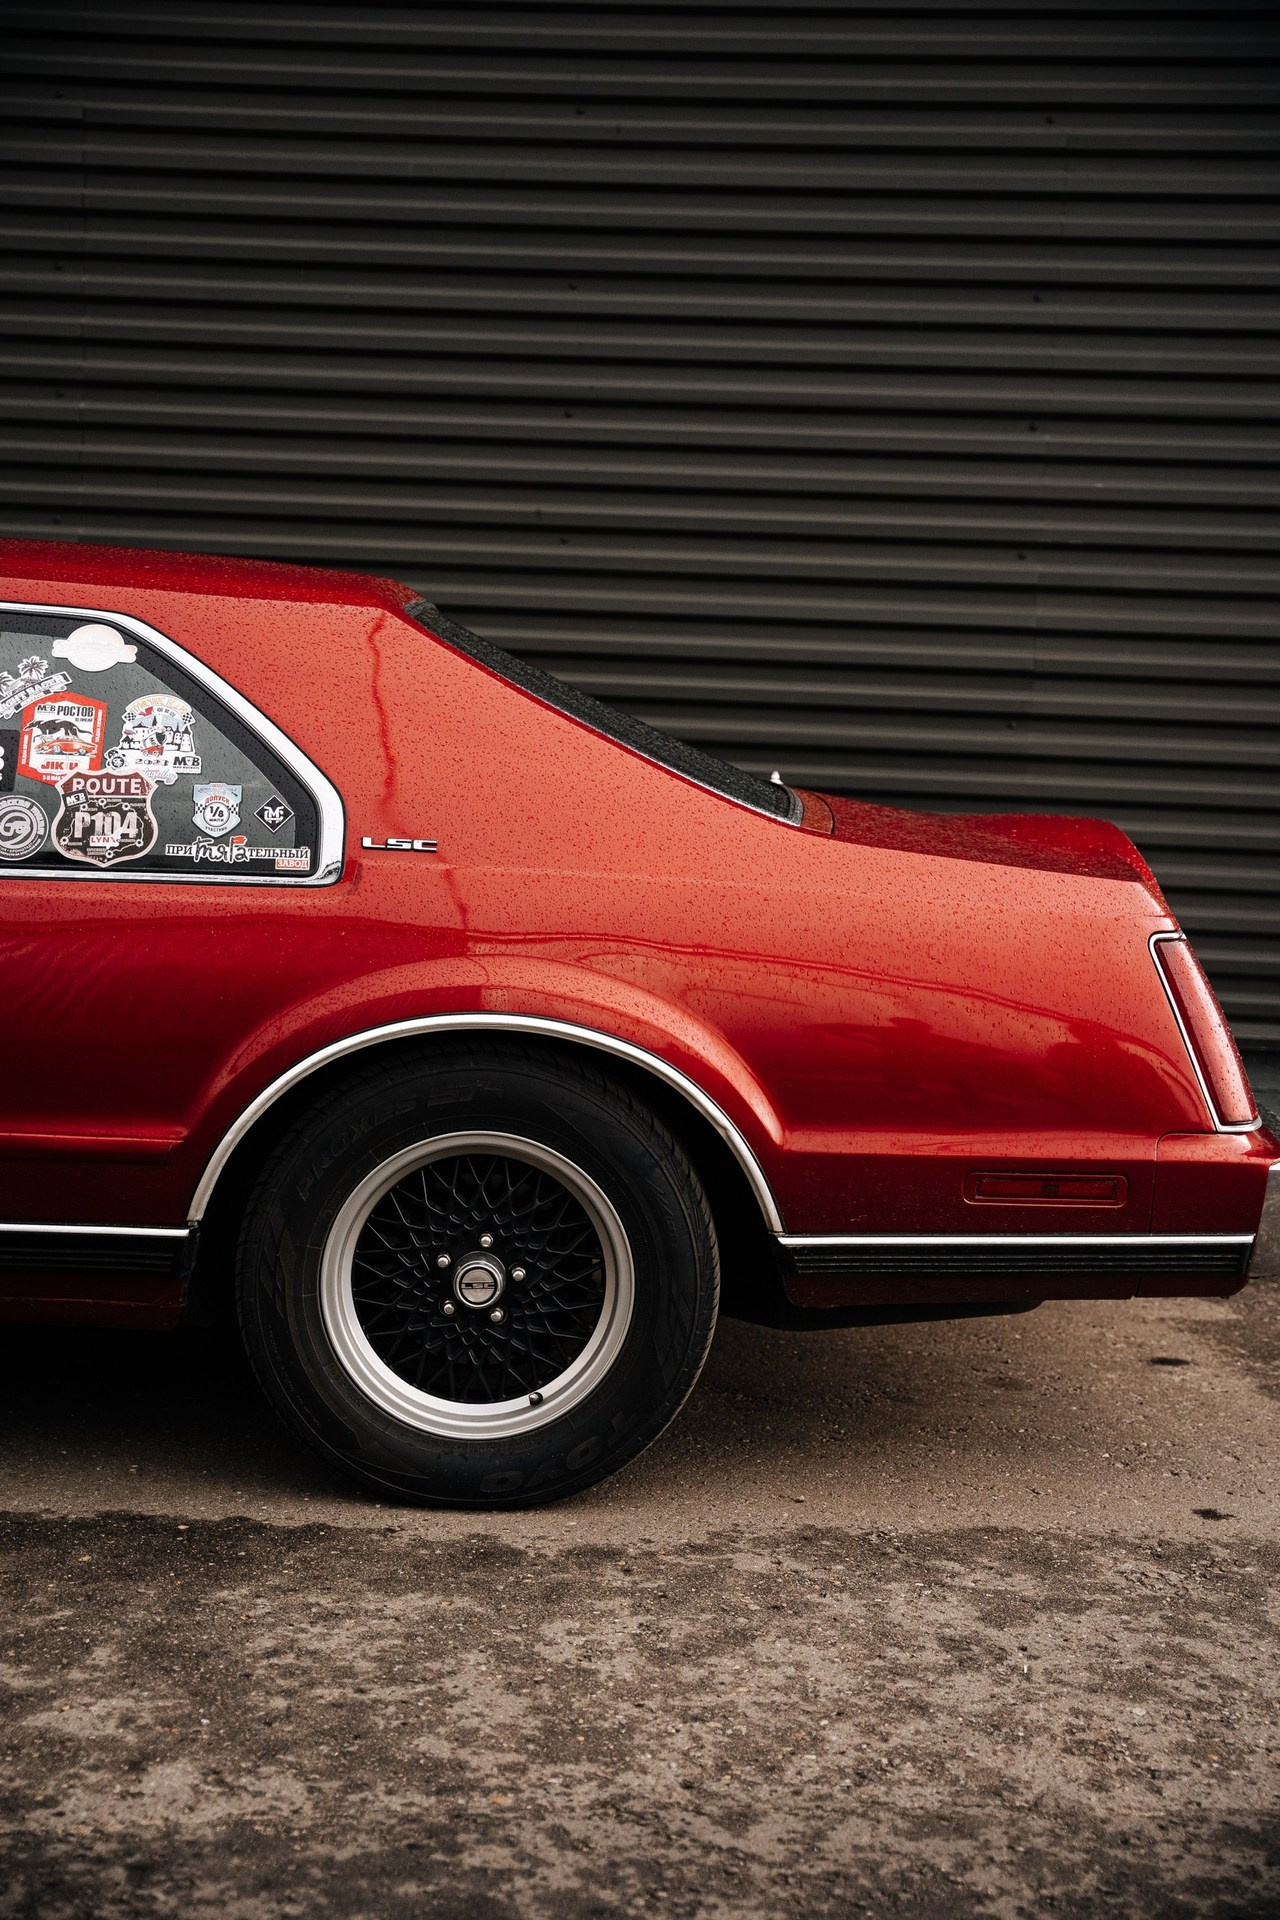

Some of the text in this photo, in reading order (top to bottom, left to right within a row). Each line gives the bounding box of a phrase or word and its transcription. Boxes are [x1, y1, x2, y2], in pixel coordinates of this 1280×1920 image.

[57, 706, 94, 717] РОСТОВ
[72, 778, 142, 795] ROUTE
[209, 806, 224, 817] 1/8
[361, 836, 438, 853] LSC
[277, 859, 308, 869] ЗАВОД
